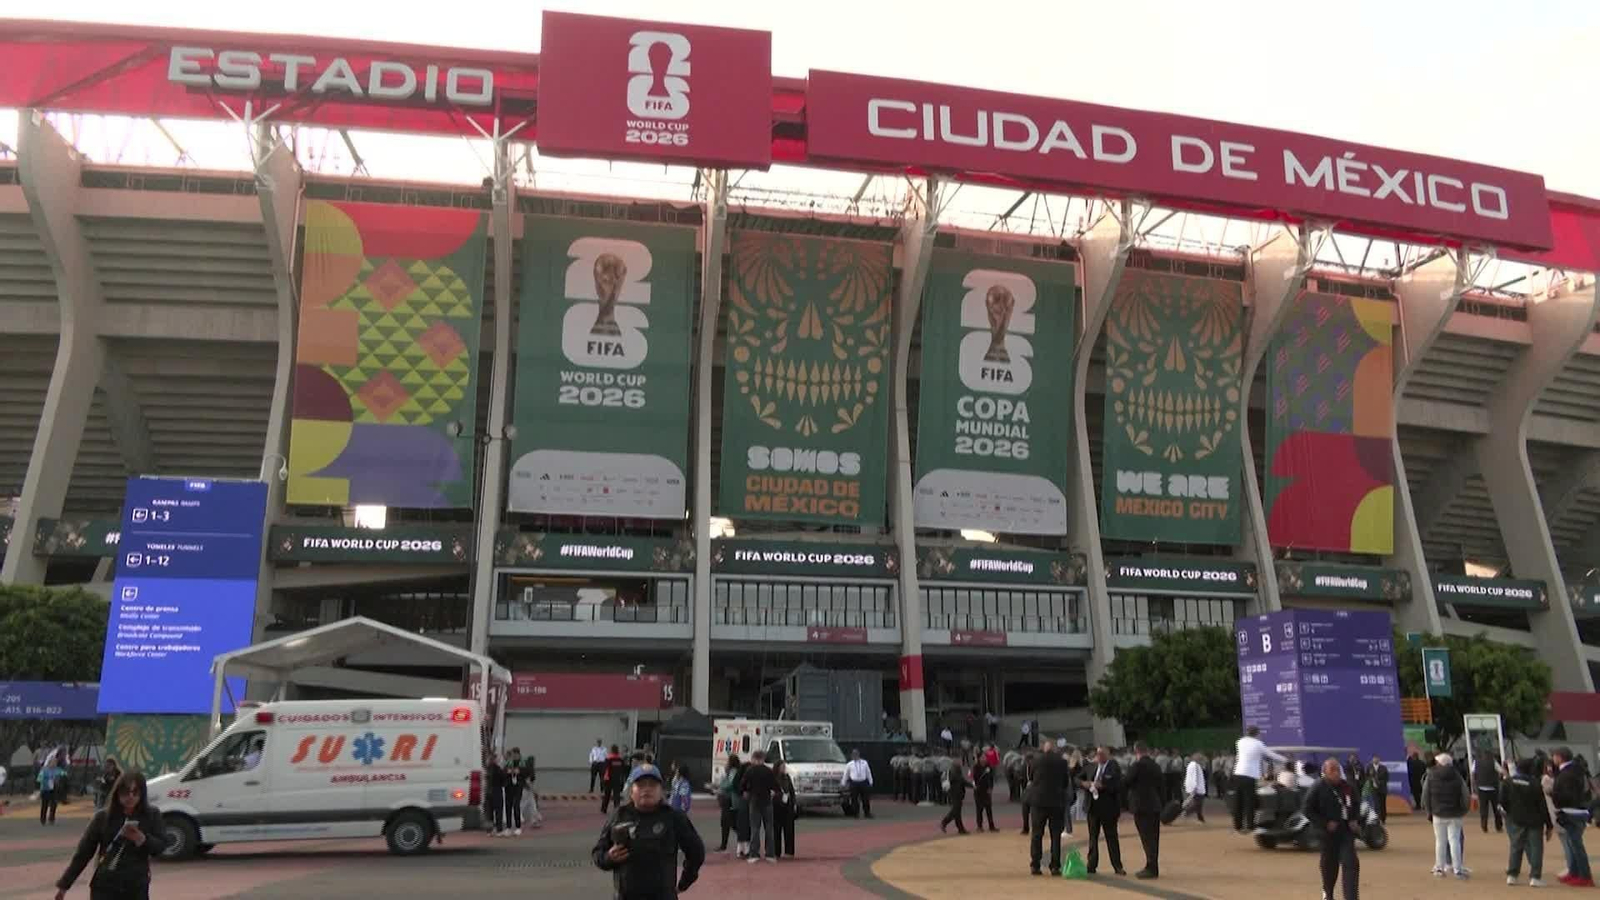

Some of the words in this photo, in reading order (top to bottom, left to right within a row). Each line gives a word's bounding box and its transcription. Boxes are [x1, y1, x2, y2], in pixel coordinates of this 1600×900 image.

[167, 45, 495, 105] ESTADIO
[645, 100, 673, 111] FIFA
[626, 120, 666, 130] WORLD
[667, 122, 689, 131] CUP
[625, 129, 689, 146] 2026
[867, 98, 1137, 164] CIUDAD
[1171, 136, 1259, 181] DE
[1283, 151, 1509, 219] MÉXICO
[587, 340, 625, 357] FIFA
[560, 371, 614, 385] WORLD
[617, 373, 646, 386] CUP
[980, 367, 1014, 383] FIFA
[558, 385, 646, 408] 2026
[956, 395, 1030, 424] COPA
[955, 419, 1029, 439] MUNDIAL
[954, 436, 1030, 461] 2026
[747, 445, 861, 476] SOMOS
[745, 475, 828, 496] CIUDAD
[833, 480, 861, 498] DE
[1116, 469, 1163, 495] WE
[1168, 474, 1230, 500] ARE
[744, 494, 861, 519] MÉXICO
[1115, 497, 1185, 518] MEXICO
[1189, 502, 1229, 520] CITY
[303, 538, 328, 548] FIFA
[331, 538, 374, 549] WORLD
[375, 539, 399, 549] CUP
[401, 540, 442, 551] 2026
[560, 545, 634, 560] #FIFAWorldCup
[735, 550, 761, 561] FIFA
[763, 551, 806, 563] WORLD
[808, 553, 832, 564] CUP
[833, 554, 875, 565] 2026
[970, 559, 1034, 574] #FIFAWorldCup
[1120, 566, 1142, 577] FIFA
[1143, 568, 1180, 579] WORLD
[1181, 569, 1201, 579] CUP
[1202, 571, 1237, 581] 2026
[1437, 583, 1456, 593] FIFA
[1456, 585, 1486, 594] WORLD
[1488, 587, 1503, 596] CUP
[1504, 588, 1533, 598] 2026
[1262, 633, 1272, 653] B
[663, 684, 673, 701] 15
[278, 713, 349, 723] CUIDADOS
[373, 712, 443, 722] INTENSIVOS
[331, 773, 407, 783] AMBULANCIA
